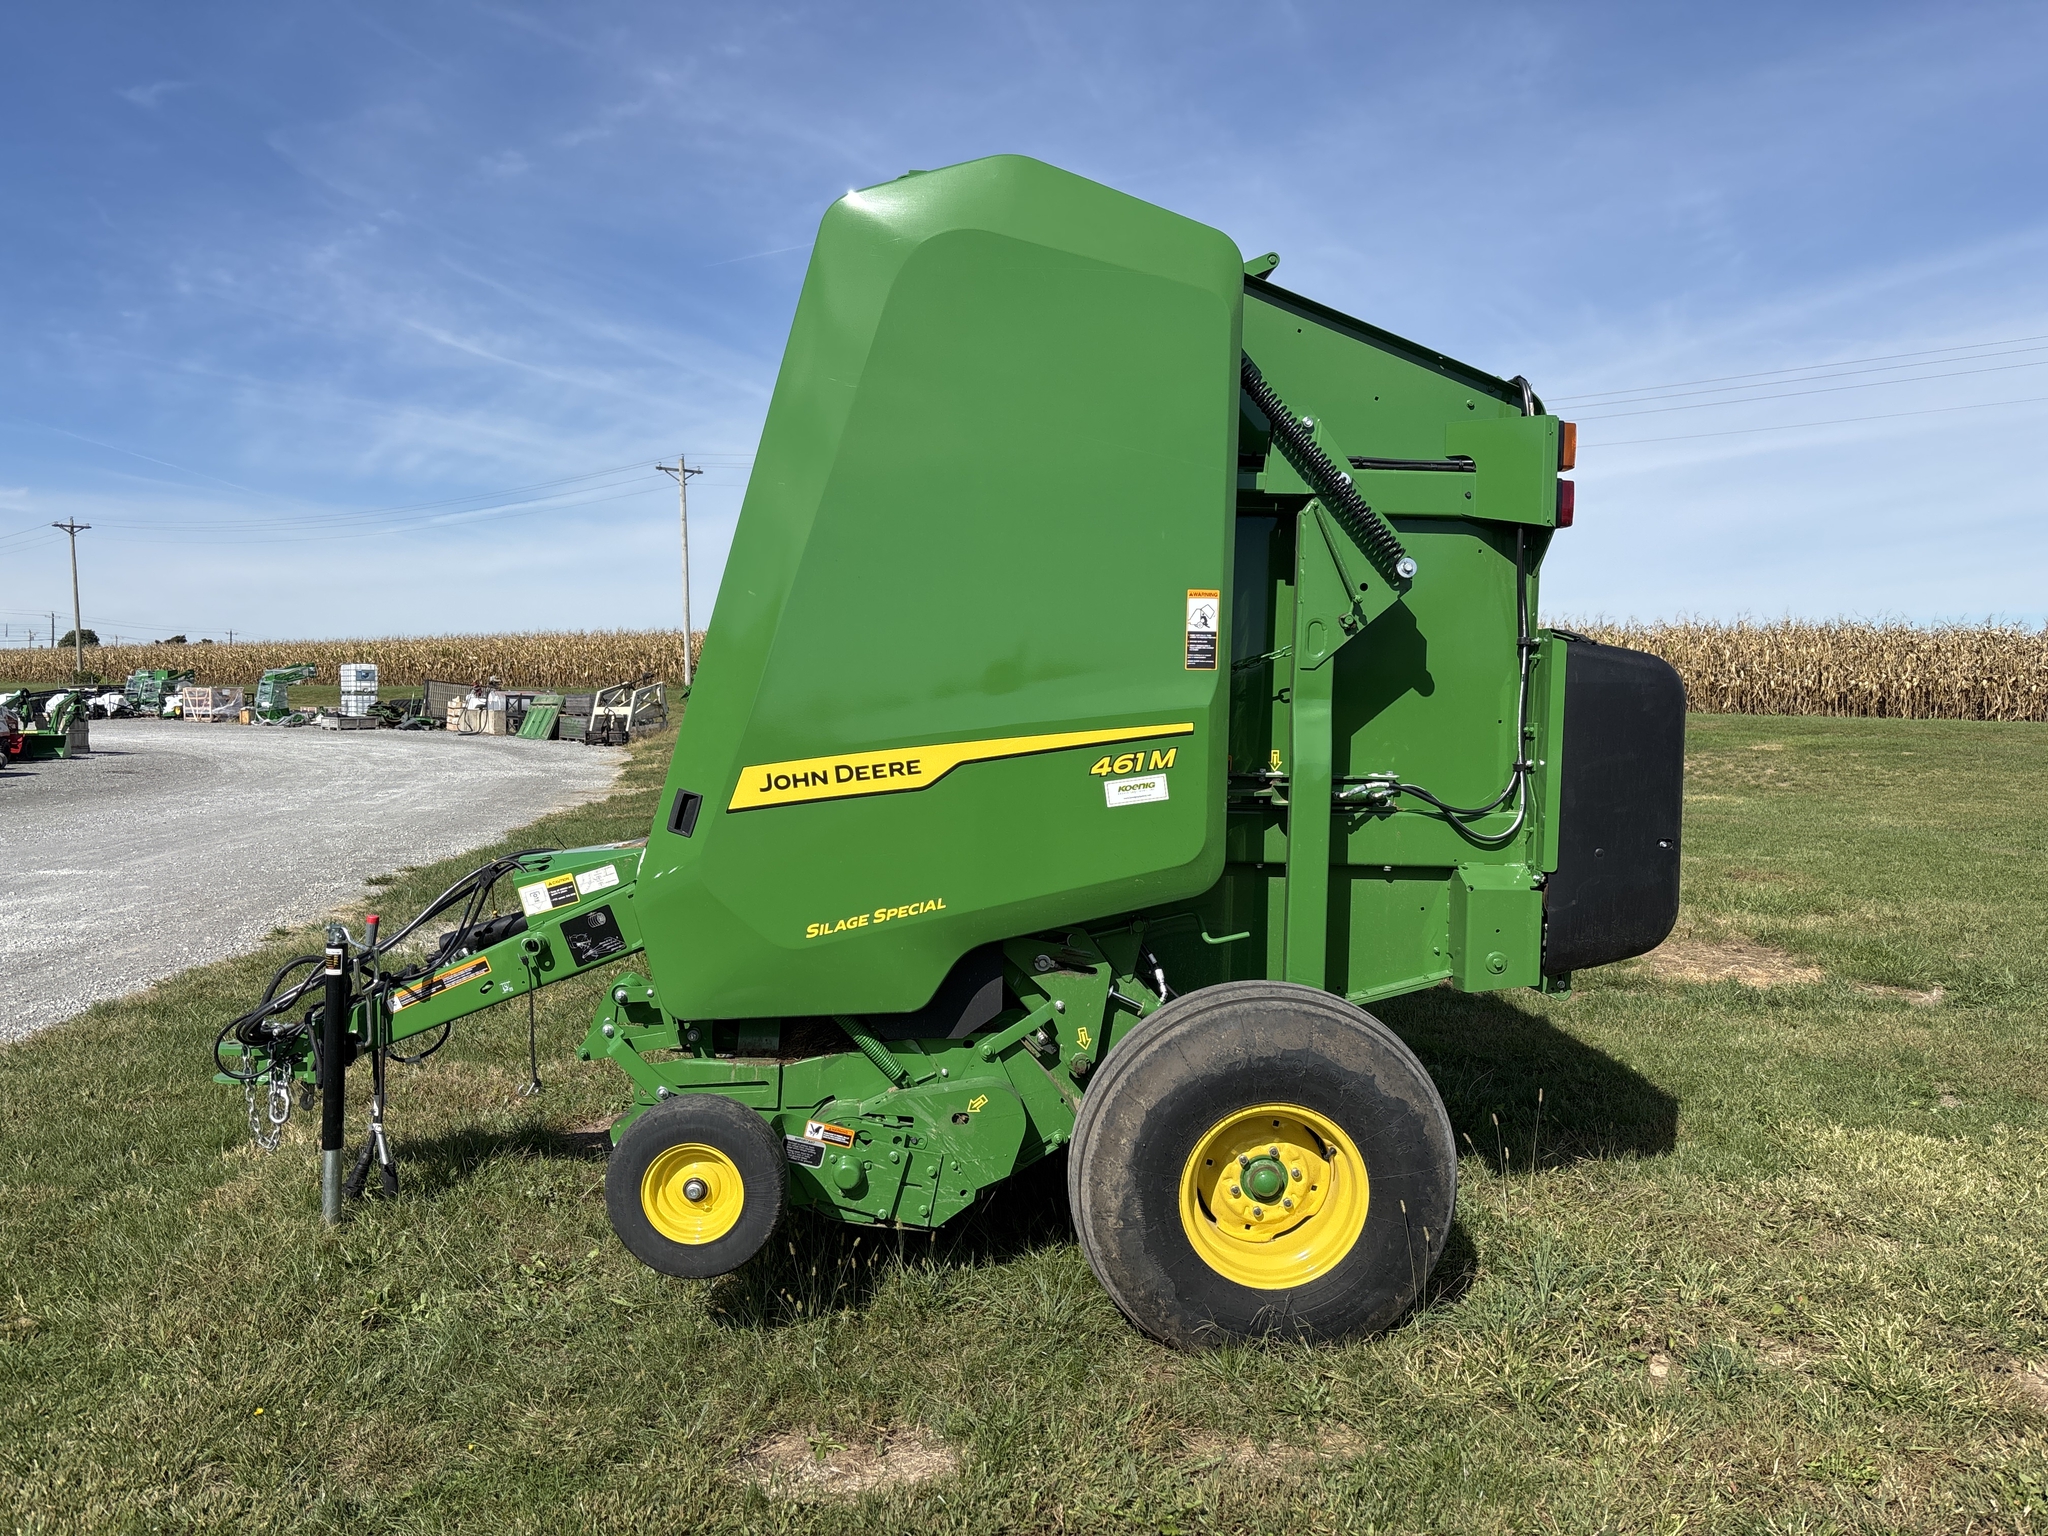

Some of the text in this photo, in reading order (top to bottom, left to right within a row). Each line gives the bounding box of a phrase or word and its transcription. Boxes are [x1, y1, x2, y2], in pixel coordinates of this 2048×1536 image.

[759, 759, 922, 793] JOHN DEERE
[805, 897, 947, 939] SILAGE SPECIAL
